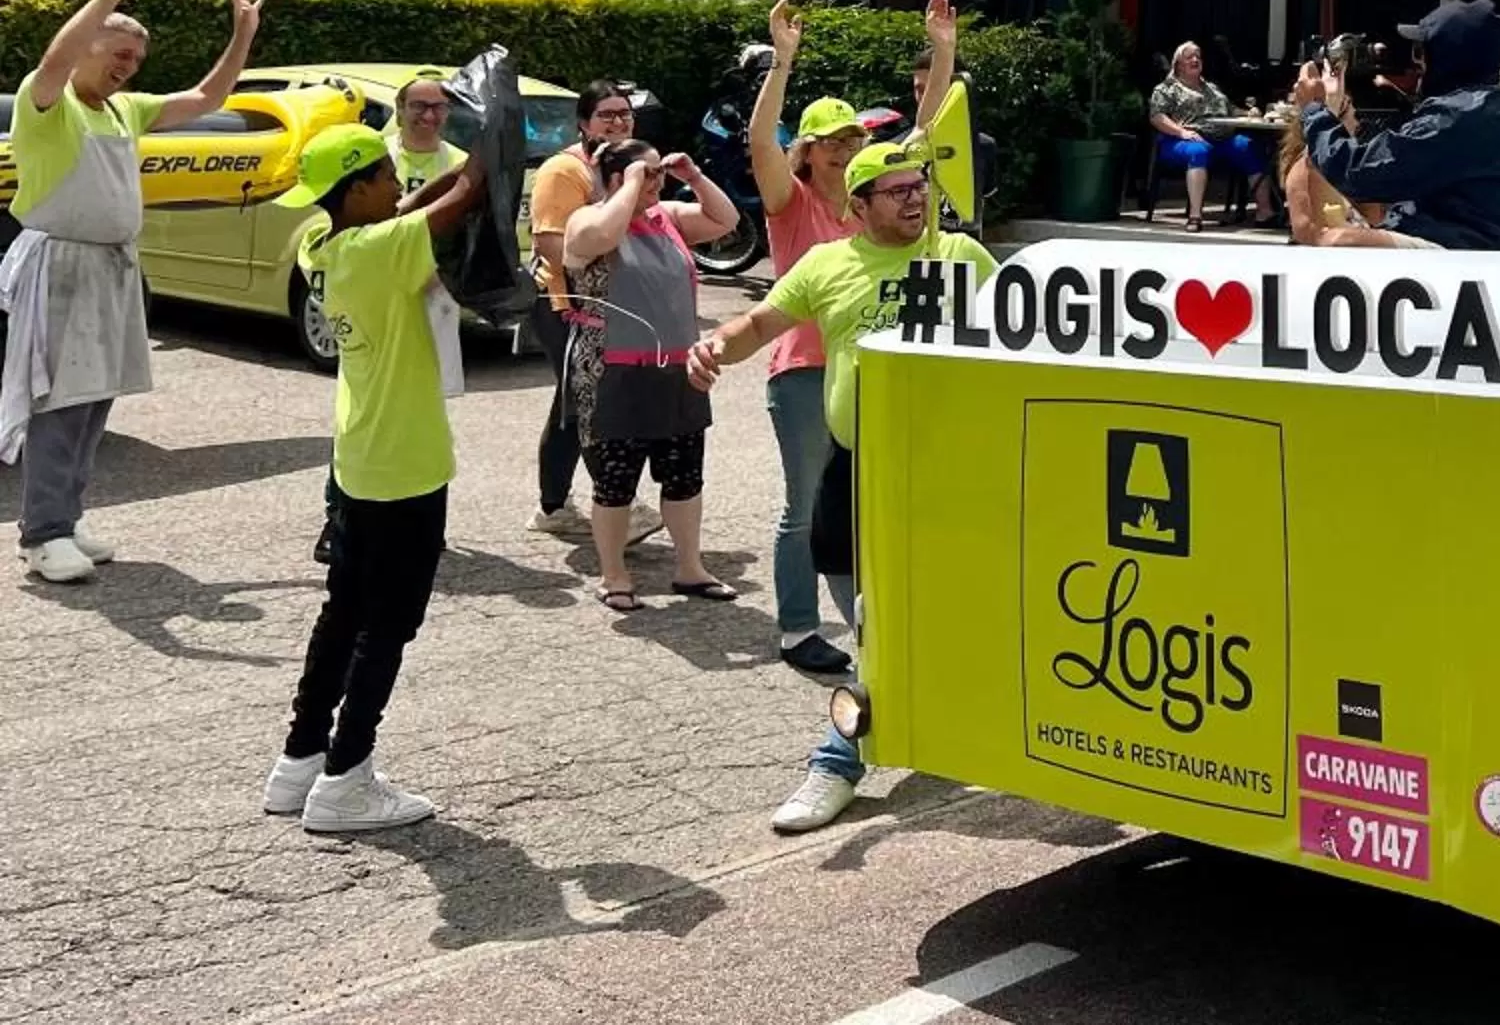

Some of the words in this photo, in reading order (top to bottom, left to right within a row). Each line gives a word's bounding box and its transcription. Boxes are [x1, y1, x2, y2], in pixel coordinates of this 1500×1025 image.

[140, 156, 262, 173] EXPLORER
[898, 259, 1168, 360] #LOGIS
[1052, 558, 1253, 733] Logis
[1037, 723, 1106, 756] HOTELS
[1113, 739, 1125, 760] &
[1131, 743, 1273, 794] RESTAURANTS
[1305, 751, 1420, 799] CARAVANE
[1347, 816, 1420, 870] 9147
